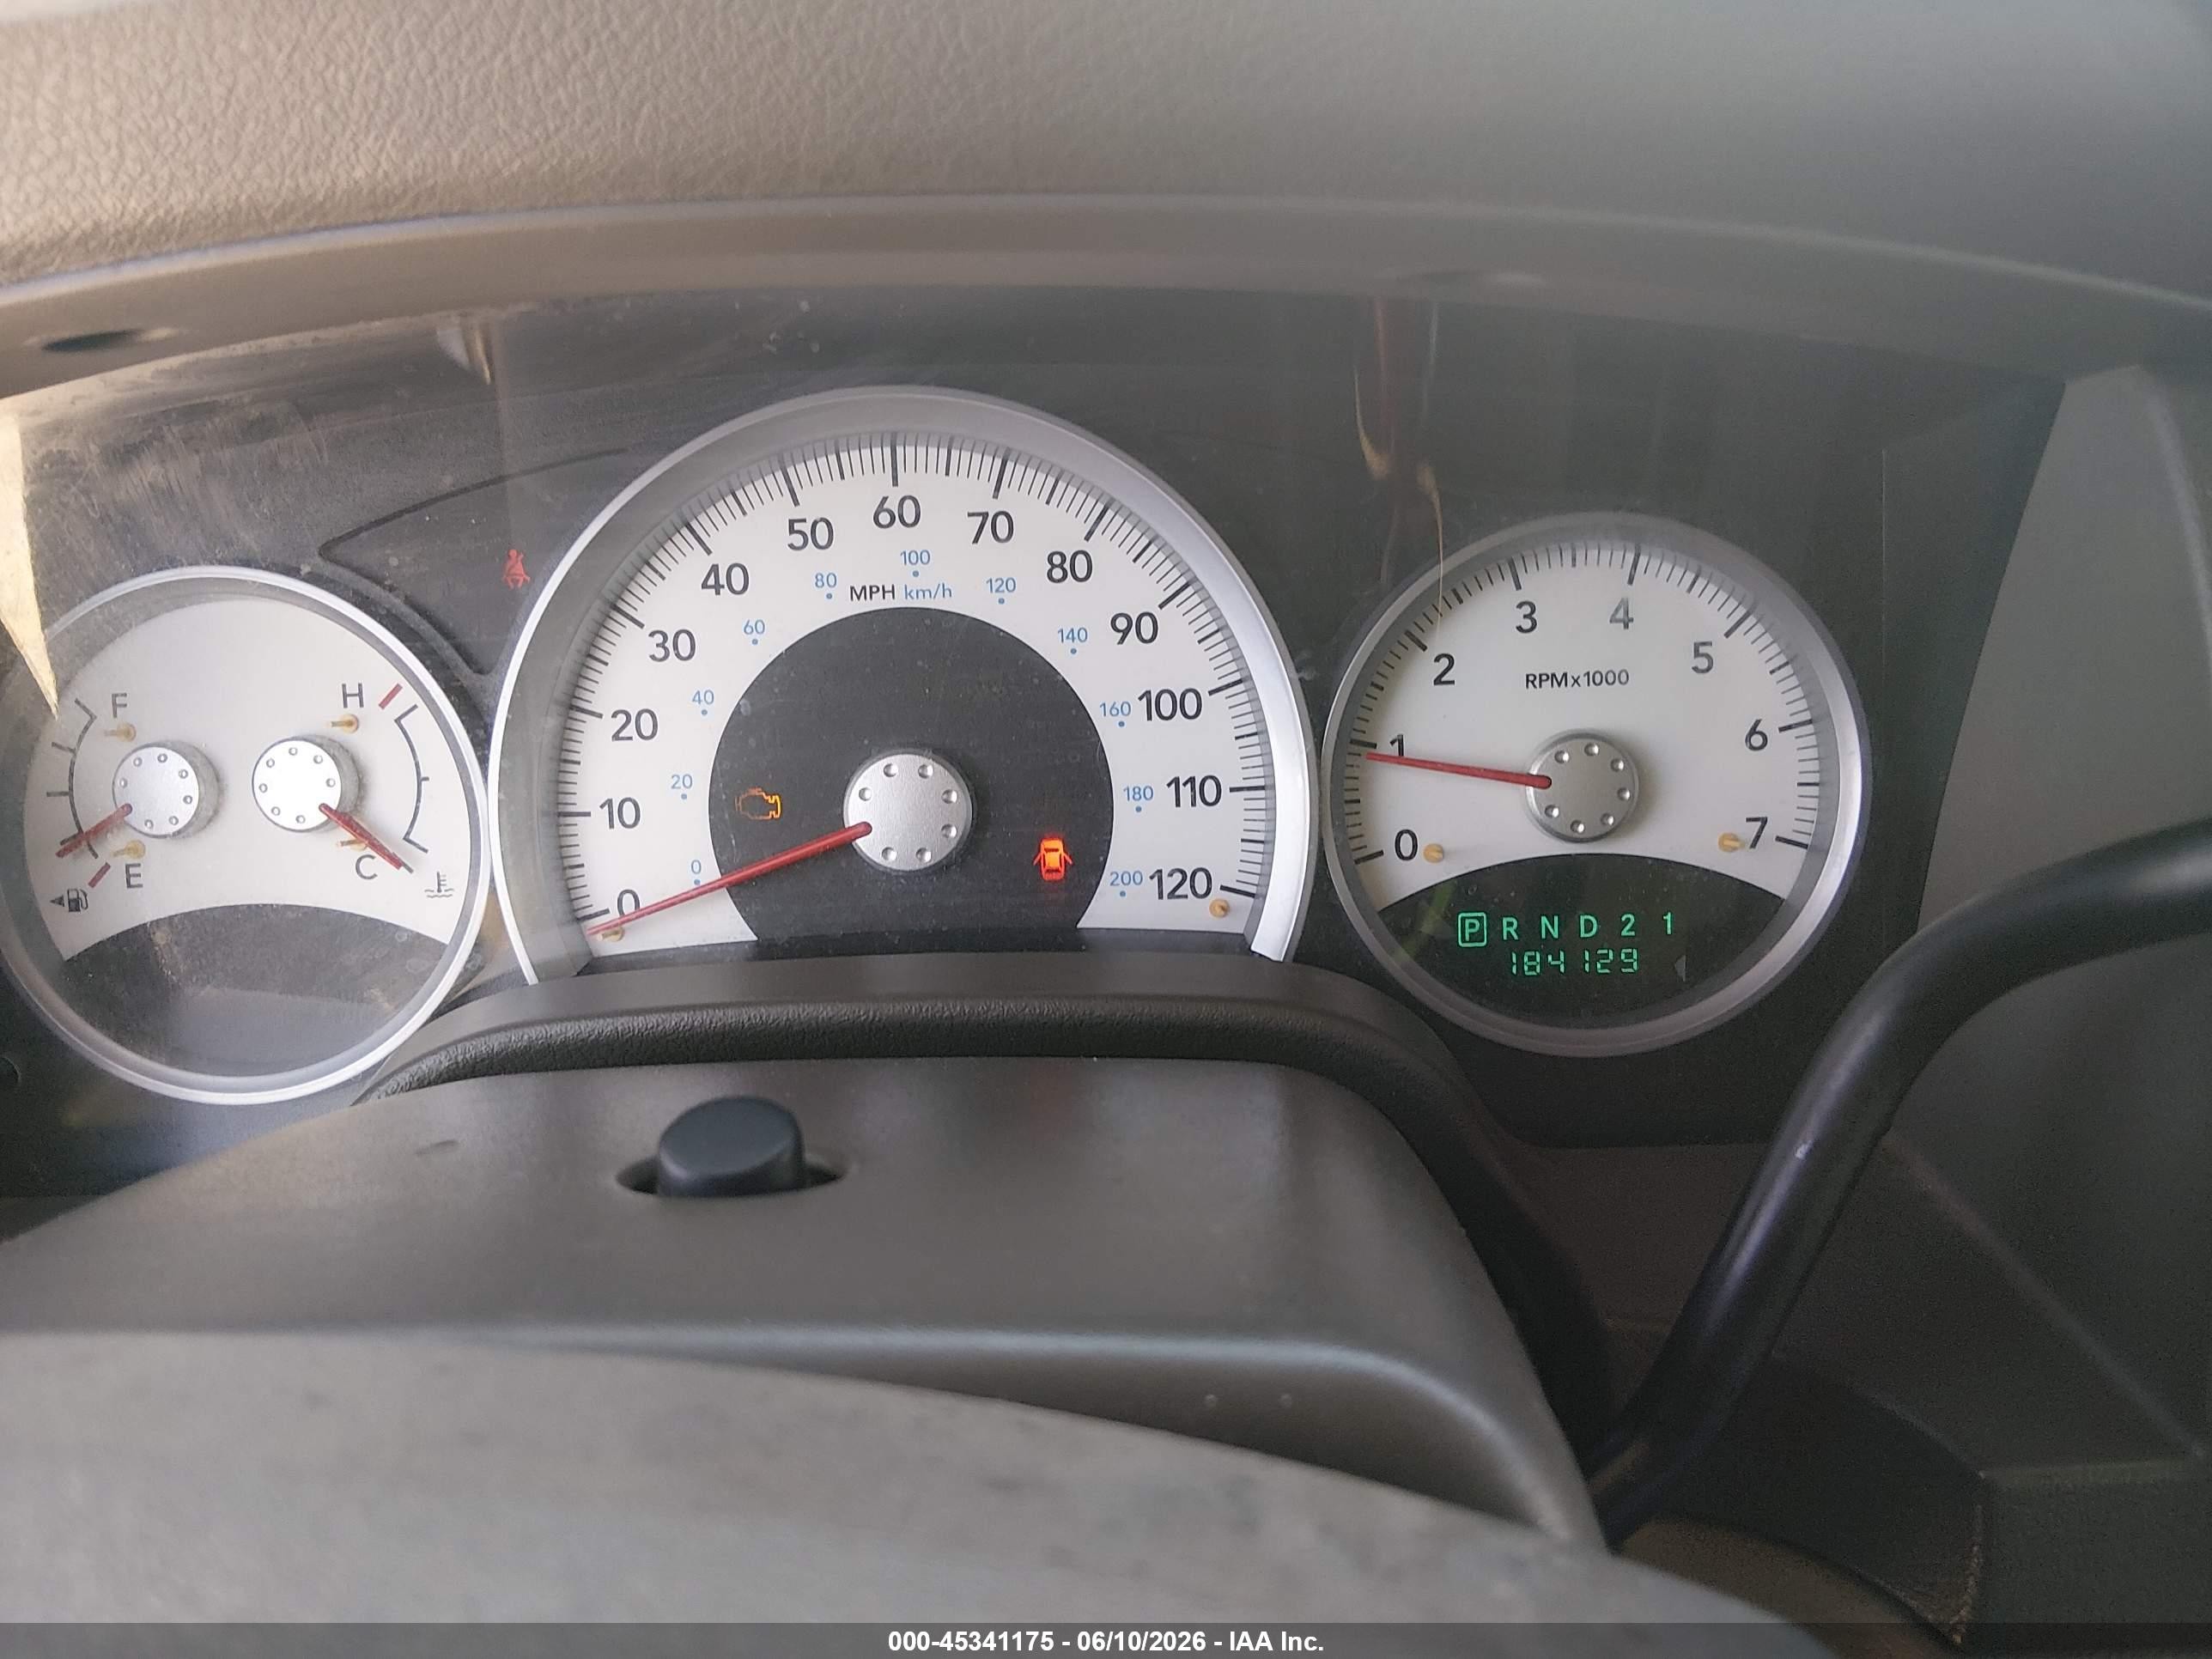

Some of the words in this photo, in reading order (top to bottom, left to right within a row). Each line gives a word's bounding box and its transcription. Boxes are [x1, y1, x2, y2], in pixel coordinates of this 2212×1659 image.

[872, 495, 921, 529] 60
[787, 518, 834, 550] 50
[968, 511, 1014, 544] 70
[900, 550, 931, 566] 100
[1046, 550, 1093, 583] 80
[701, 562, 750, 595] 40
[814, 573, 837, 587] 80
[850, 585, 896, 600] MPH
[903, 583, 952, 600] km/h
[987, 578, 1016, 594] 120
[743, 620, 765, 635] 60
[1110, 611, 1159, 645] 90
[1516, 601, 1538, 633] 3
[1609, 599, 1634, 629] 4
[647, 629, 696, 662] 30
[1058, 628, 1087, 643] 140
[1433, 654, 1455, 685] 2
[1692, 641, 1714, 673] 5
[112, 694, 127, 718] F
[342, 684, 364, 708] H
[691, 690, 714, 706] 40
[1100, 702, 1131, 717] 160
[1138, 688, 1202, 721] 100
[611, 708, 658, 741] 20
[1746, 719, 1768, 750] 6
[1389, 734, 1405, 757] 1
[671, 775, 692, 789] 20
[1123, 786, 1153, 801] 180
[1166, 775, 1221, 808] 110
[599, 797, 641, 829] 10
[1395, 830, 1418, 860] 0
[1746, 817, 1768, 848] 7
[126, 864, 143, 888] E
[356, 854, 377, 880] C
[691, 860, 702, 874] 0
[1109, 871, 1142, 886] 200
[1149, 868, 1212, 900] 120
[617, 889, 641, 917] 0
[1464, 918, 1480, 941] P
[1503, 917, 1518, 940] R
[1541, 915, 1559, 939] N
[1580, 915, 1598, 938] D
[1620, 914, 1636, 937] 2
[1663, 912, 1674, 935] 1
[1511, 949, 1638, 975] 184129
